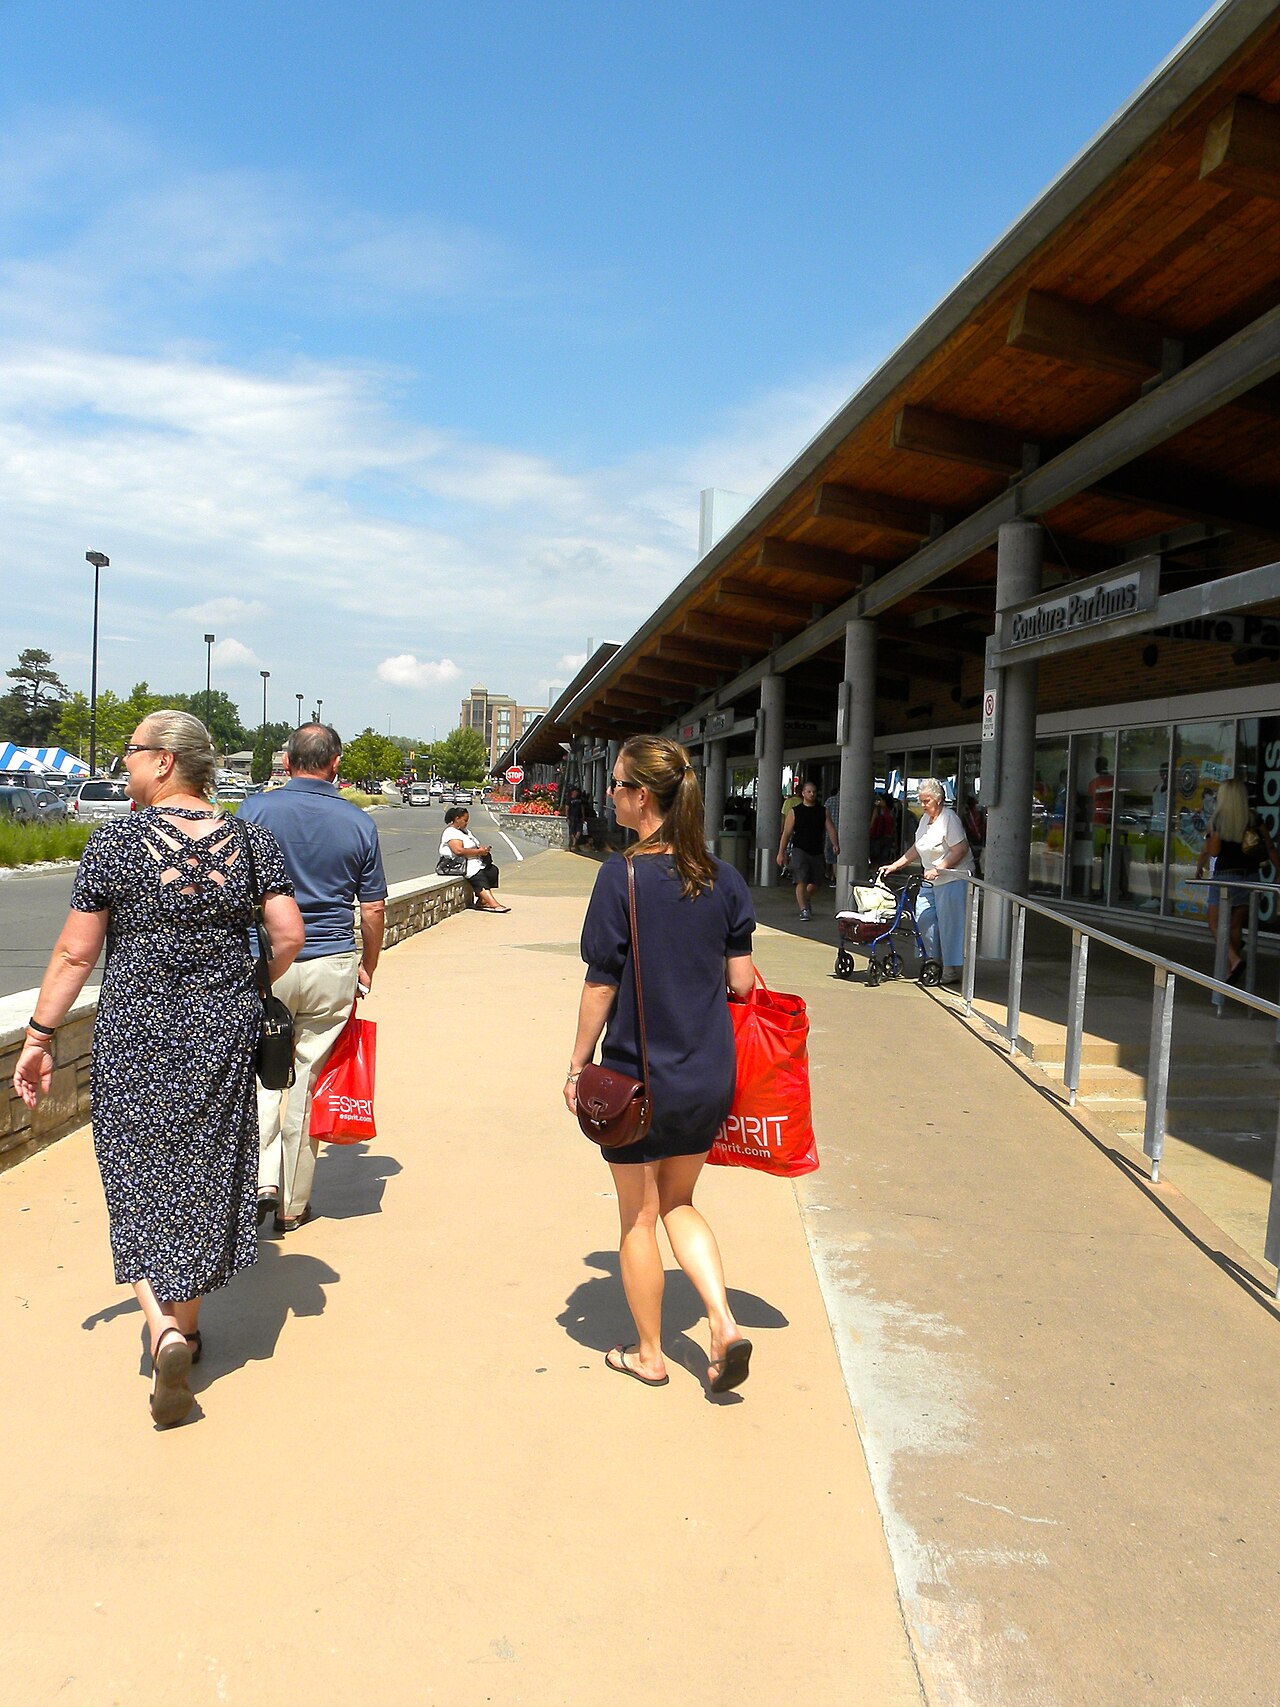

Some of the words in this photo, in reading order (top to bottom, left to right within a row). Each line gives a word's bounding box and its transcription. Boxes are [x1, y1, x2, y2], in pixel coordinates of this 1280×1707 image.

[1012, 606, 1065, 641] Couture
[1067, 584, 1137, 627] Parfums
[507, 771, 523, 779] STOP
[339, 1113, 373, 1123] esprit.com
[713, 1141, 772, 1158] sprit.com
